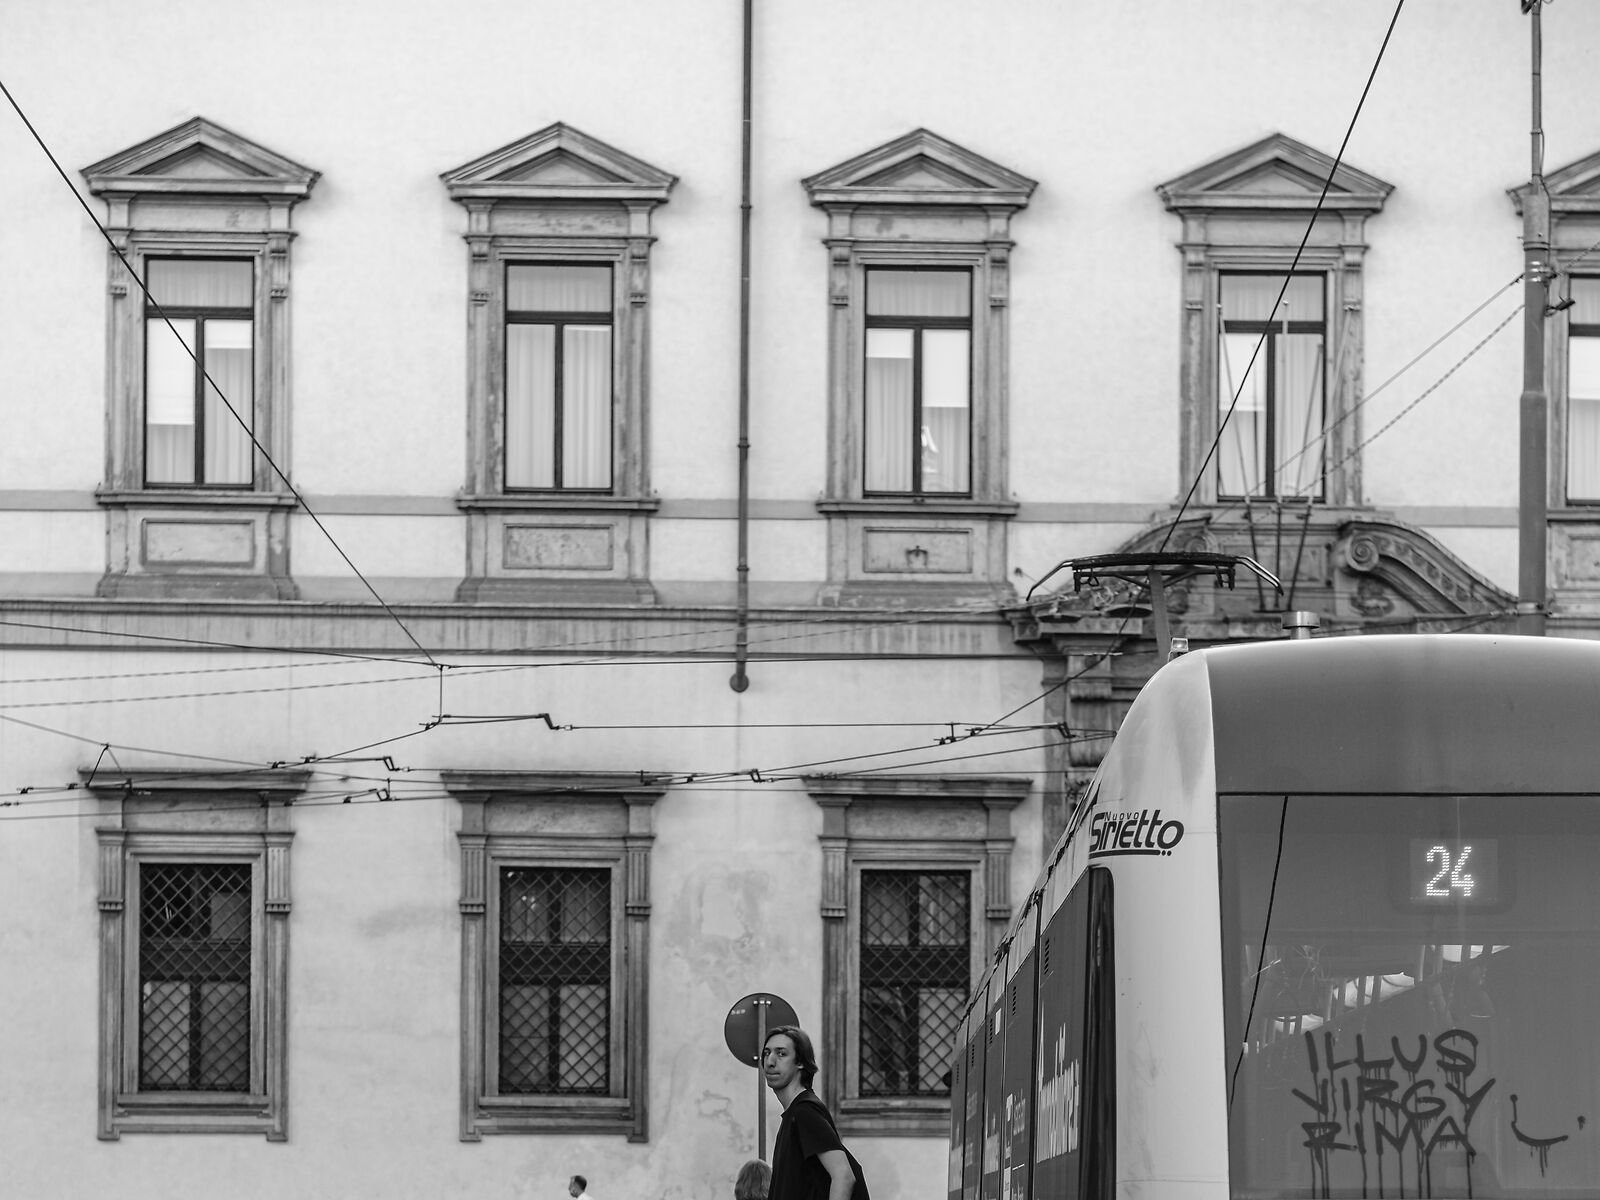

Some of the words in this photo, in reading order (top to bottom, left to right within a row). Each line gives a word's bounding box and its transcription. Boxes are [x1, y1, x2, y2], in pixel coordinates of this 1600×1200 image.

[1104, 811, 1140, 821] Nuovo
[1426, 846, 1474, 896] 24
[1305, 1029, 1479, 1077] ILLUS
[1291, 1077, 1496, 1125] VIRGY
